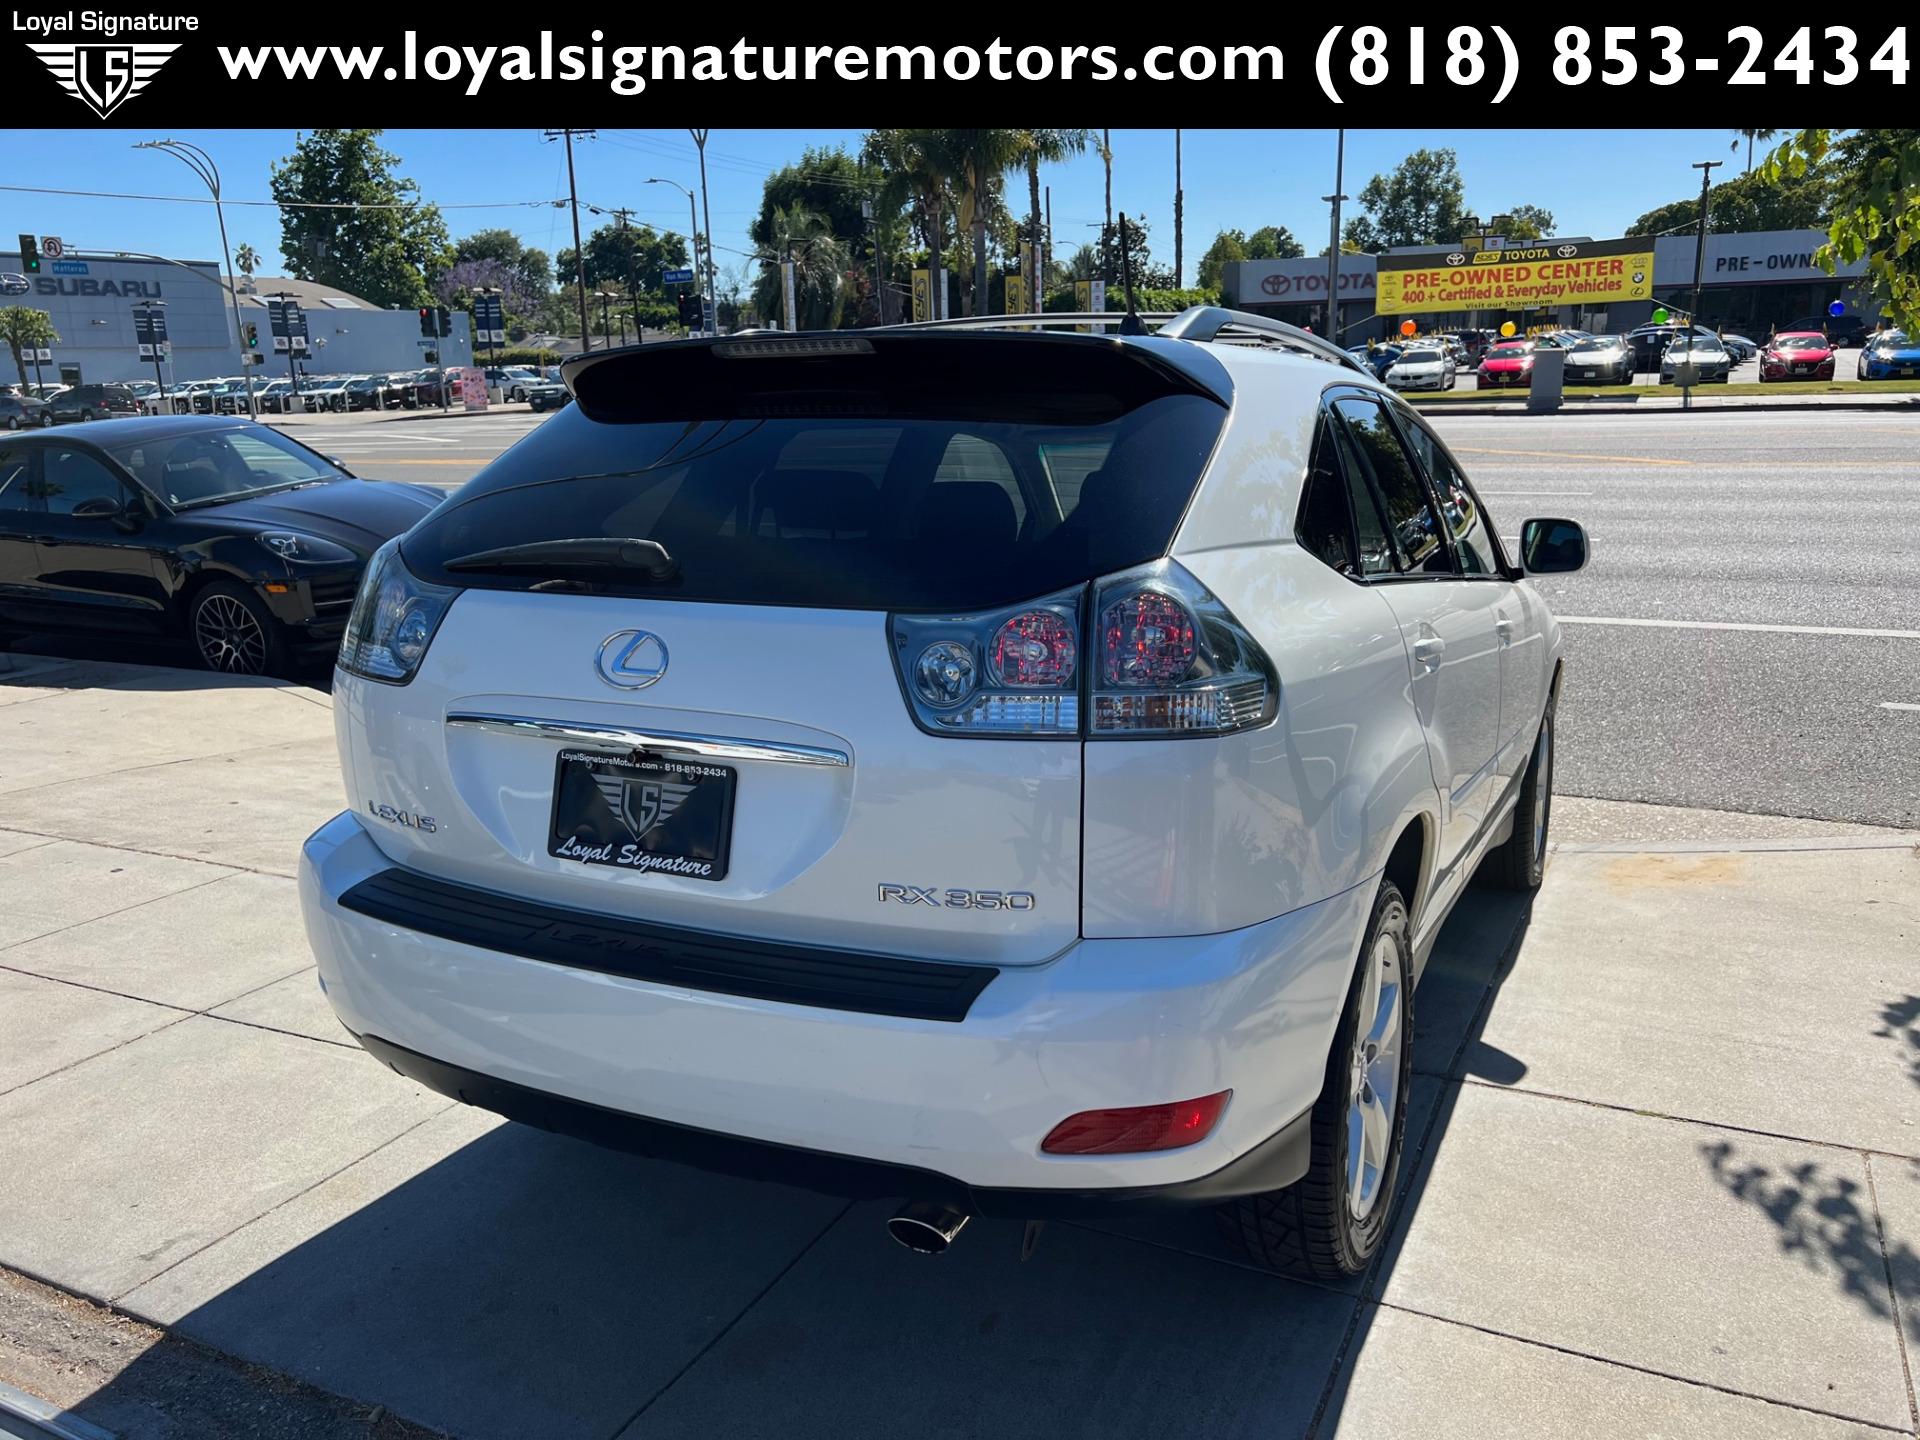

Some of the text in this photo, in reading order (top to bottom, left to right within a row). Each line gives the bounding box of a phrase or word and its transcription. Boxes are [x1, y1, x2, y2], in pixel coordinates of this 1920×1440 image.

[1504, 249, 1550, 260] TOYOTA
[1716, 253, 1819, 272] PRE-OWN
[1402, 259, 1624, 288] PRE-OWNED CENTER
[34, 277, 161, 298] SUBARU
[1402, 290, 1425, 303] 400
[1438, 285, 1491, 301] Certified
[1494, 285, 1504, 298] &
[1506, 282, 1566, 299] Everyday
[1568, 278, 1622, 294] Vehicles
[1504, 299, 1553, 307] Showroom
[664, 763, 727, 777] 818-853-2434
[368, 799, 437, 833] LEXUS
[556, 835, 712, 876] Loyal Signature
[878, 882, 1035, 911] RX 350
